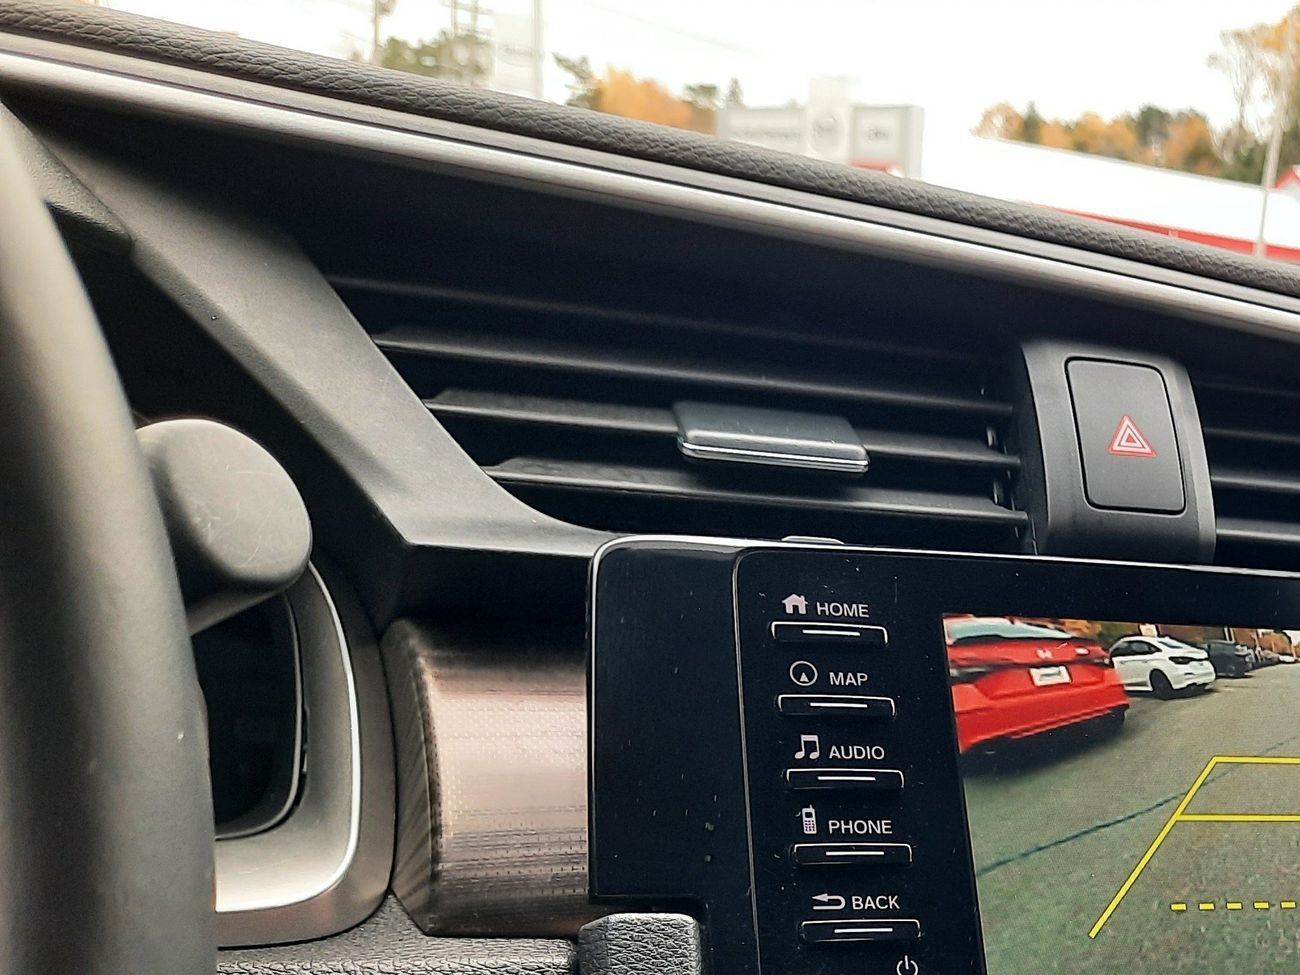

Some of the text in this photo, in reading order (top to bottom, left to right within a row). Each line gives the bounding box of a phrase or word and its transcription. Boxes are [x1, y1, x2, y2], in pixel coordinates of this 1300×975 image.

[816, 602, 869, 618] HOME
[829, 671, 868, 686] MAP
[829, 746, 885, 760] AUDIO
[828, 820, 893, 835] PHONE
[851, 895, 900, 910] BACK
